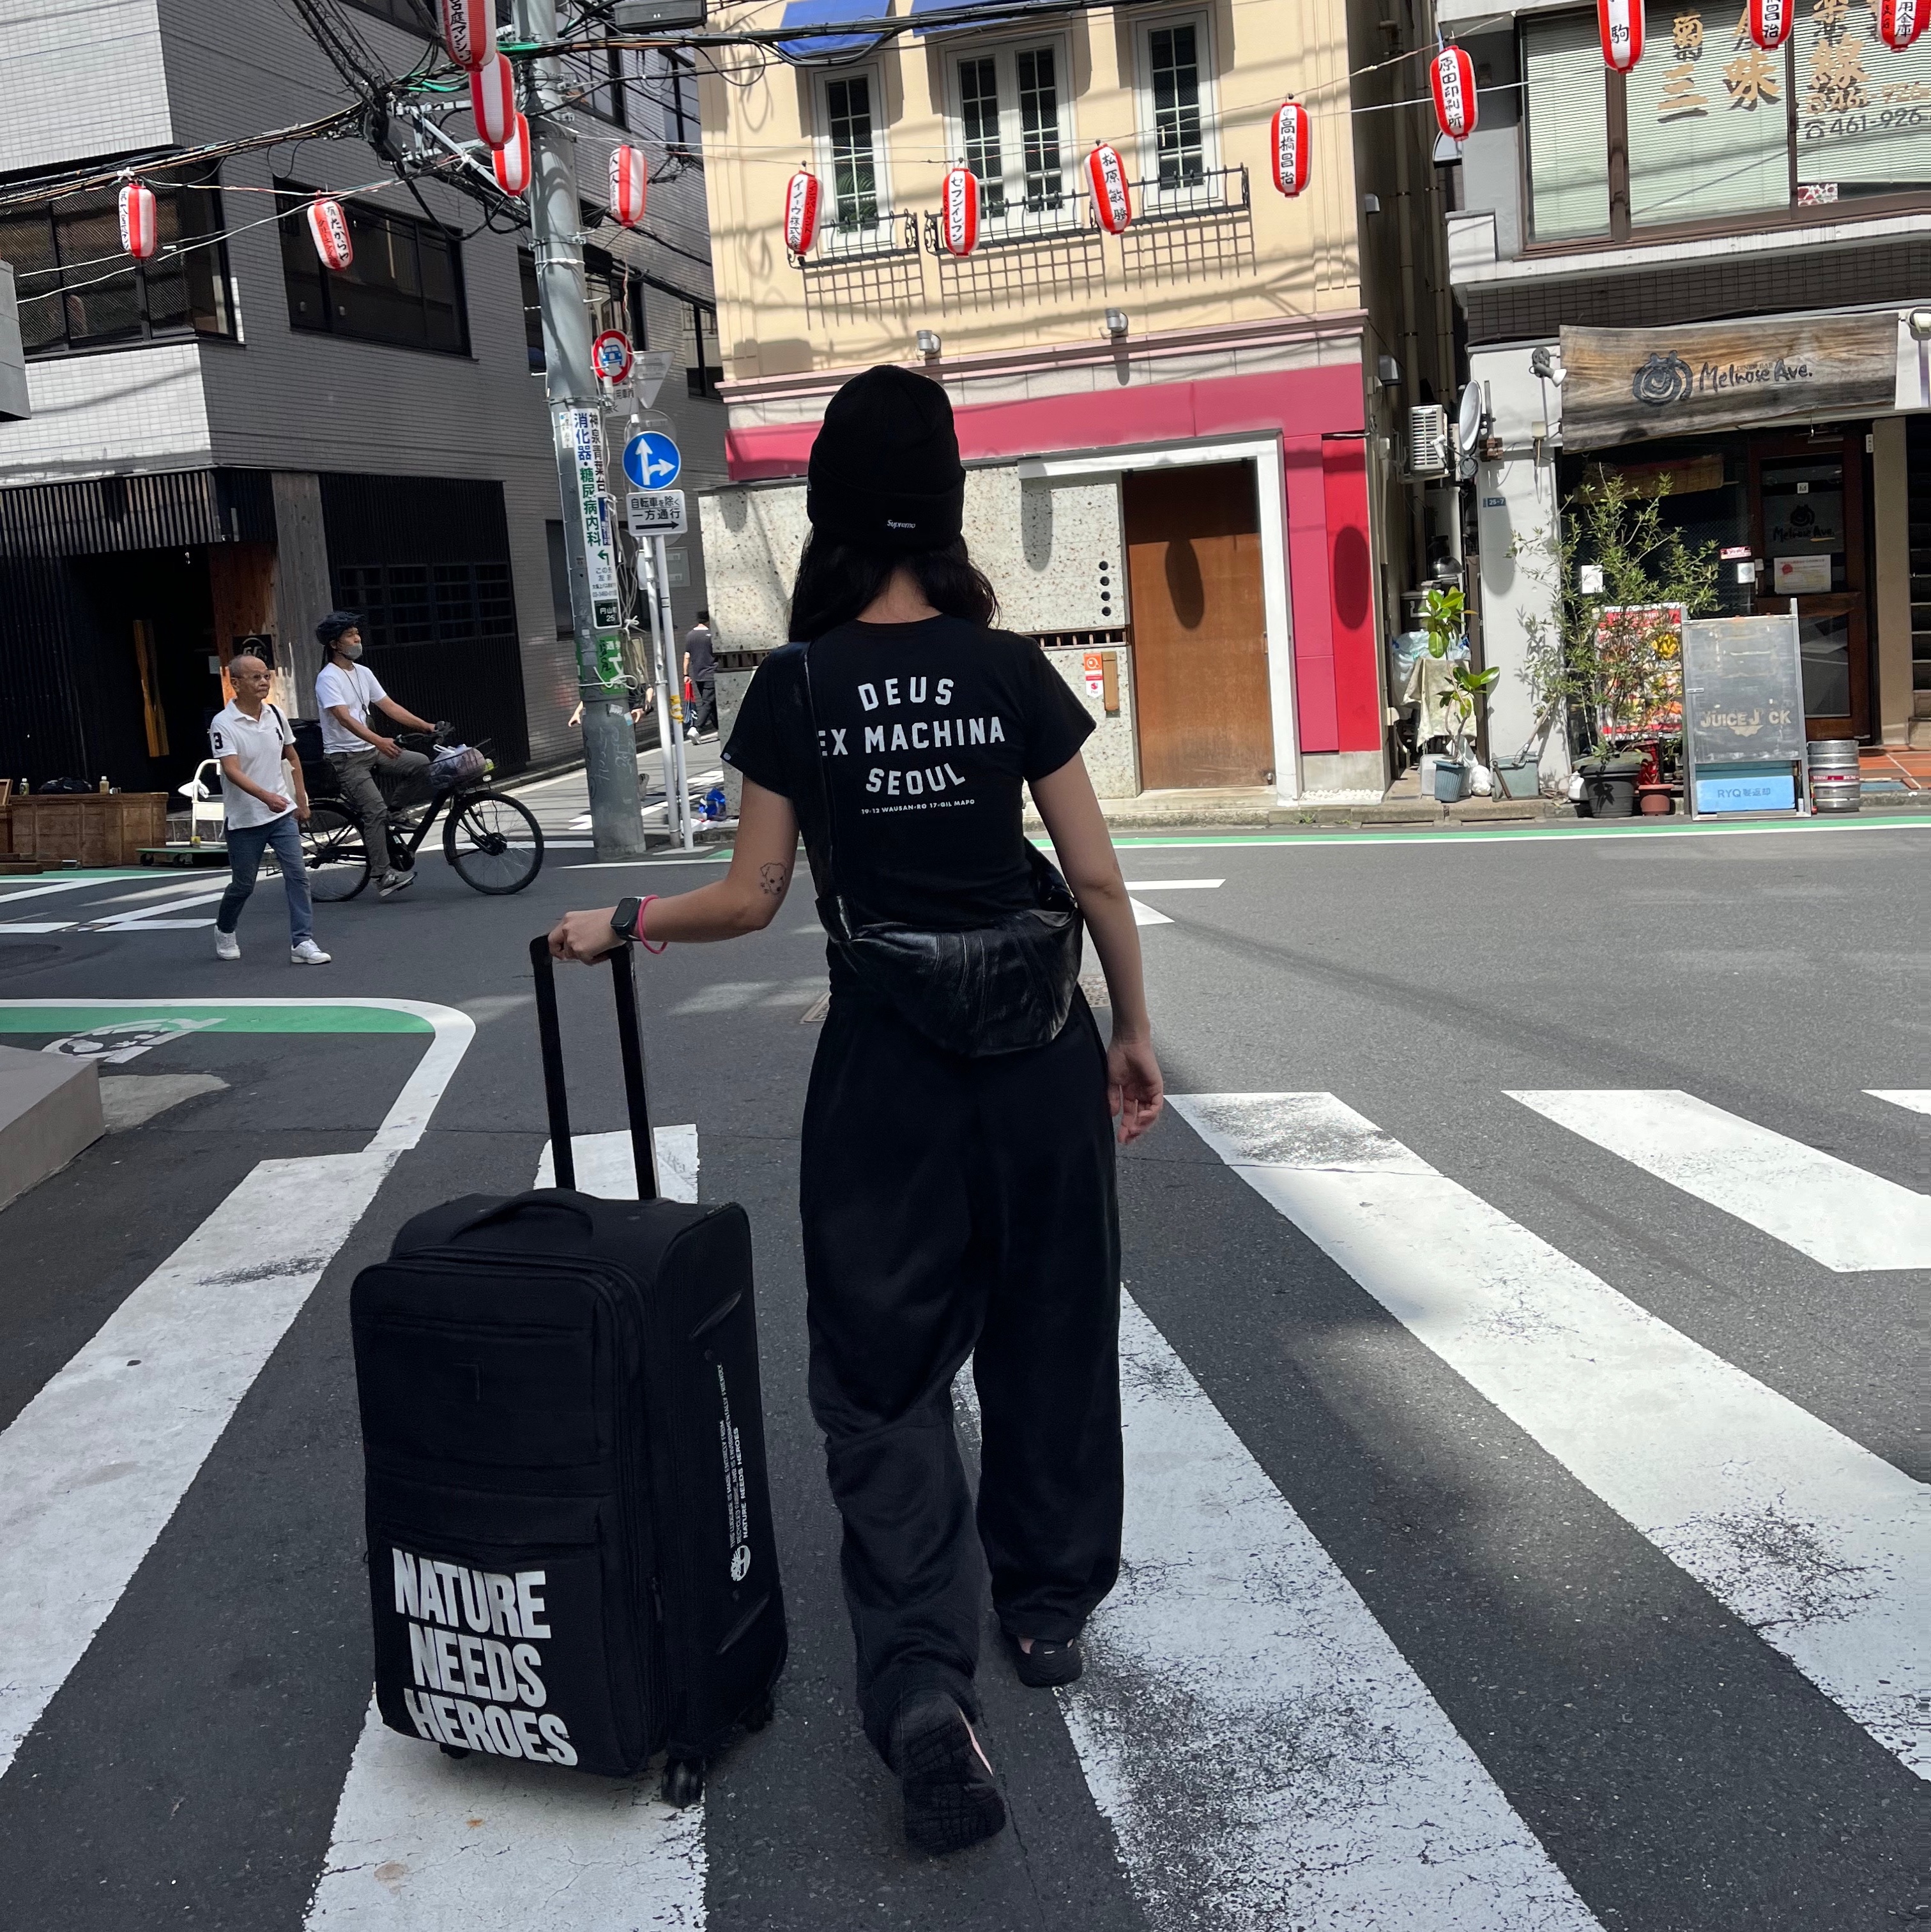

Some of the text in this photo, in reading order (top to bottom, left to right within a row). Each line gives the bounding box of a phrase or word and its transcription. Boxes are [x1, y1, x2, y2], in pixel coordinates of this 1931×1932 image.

[1762, 0, 1780, 38] 昌治
[950, 176, 965, 242] セブンイレブン
[1775, 359, 1813, 382] Ave.
[631, 496, 680, 509] 自転車を除く
[632, 508, 680, 521] 一方通行
[858, 676, 954, 711] DEUS
[864, 716, 1005, 754] MACHINA
[1748, 709, 1791, 726] JCK
[213, 732, 224, 750] 3
[866, 763, 966, 795] SEOUL
[733, 1426, 742, 1464] HEROES
[392, 1548, 551, 1639] NATURE
[409, 1622, 547, 1708] NEEDS
[403, 1687, 578, 1765] HEROES
